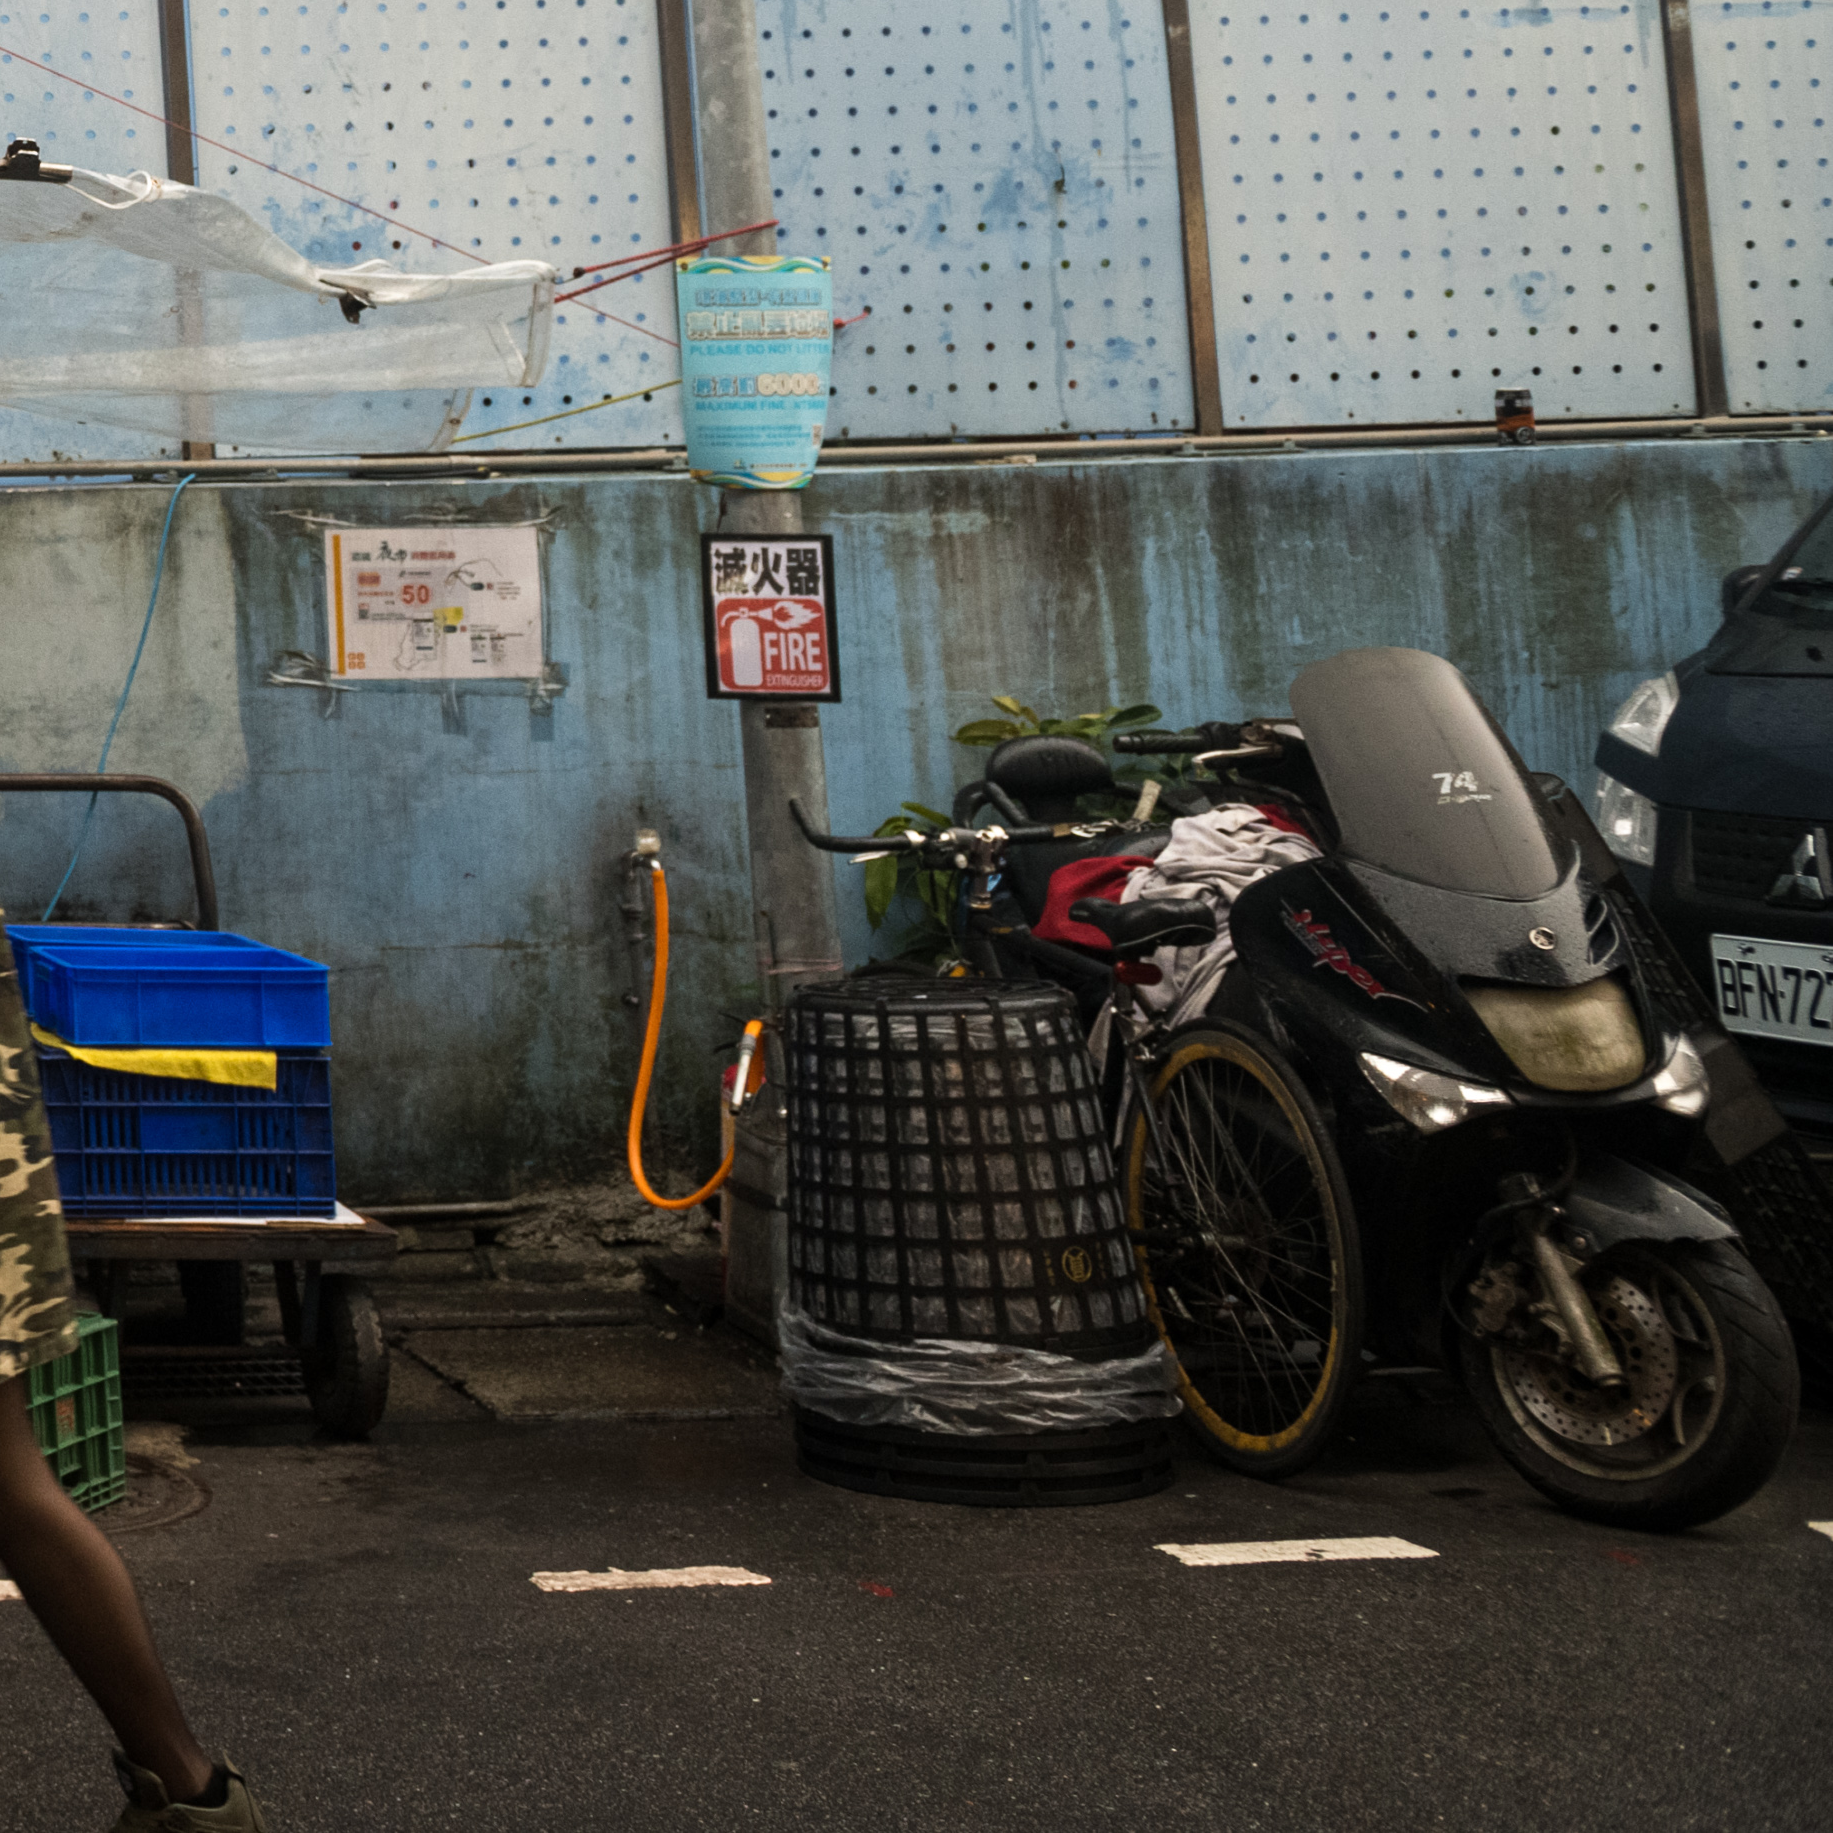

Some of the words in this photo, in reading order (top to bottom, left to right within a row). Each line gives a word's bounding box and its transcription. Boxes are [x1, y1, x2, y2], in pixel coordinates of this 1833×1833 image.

[715, 547, 821, 596] 滅火器
[402, 585, 430, 605] 50
[764, 632, 822, 671] FIRE
[766, 673, 823, 687] EXTINGUISHER
[1717, 959, 1833, 1029] BFN-72
